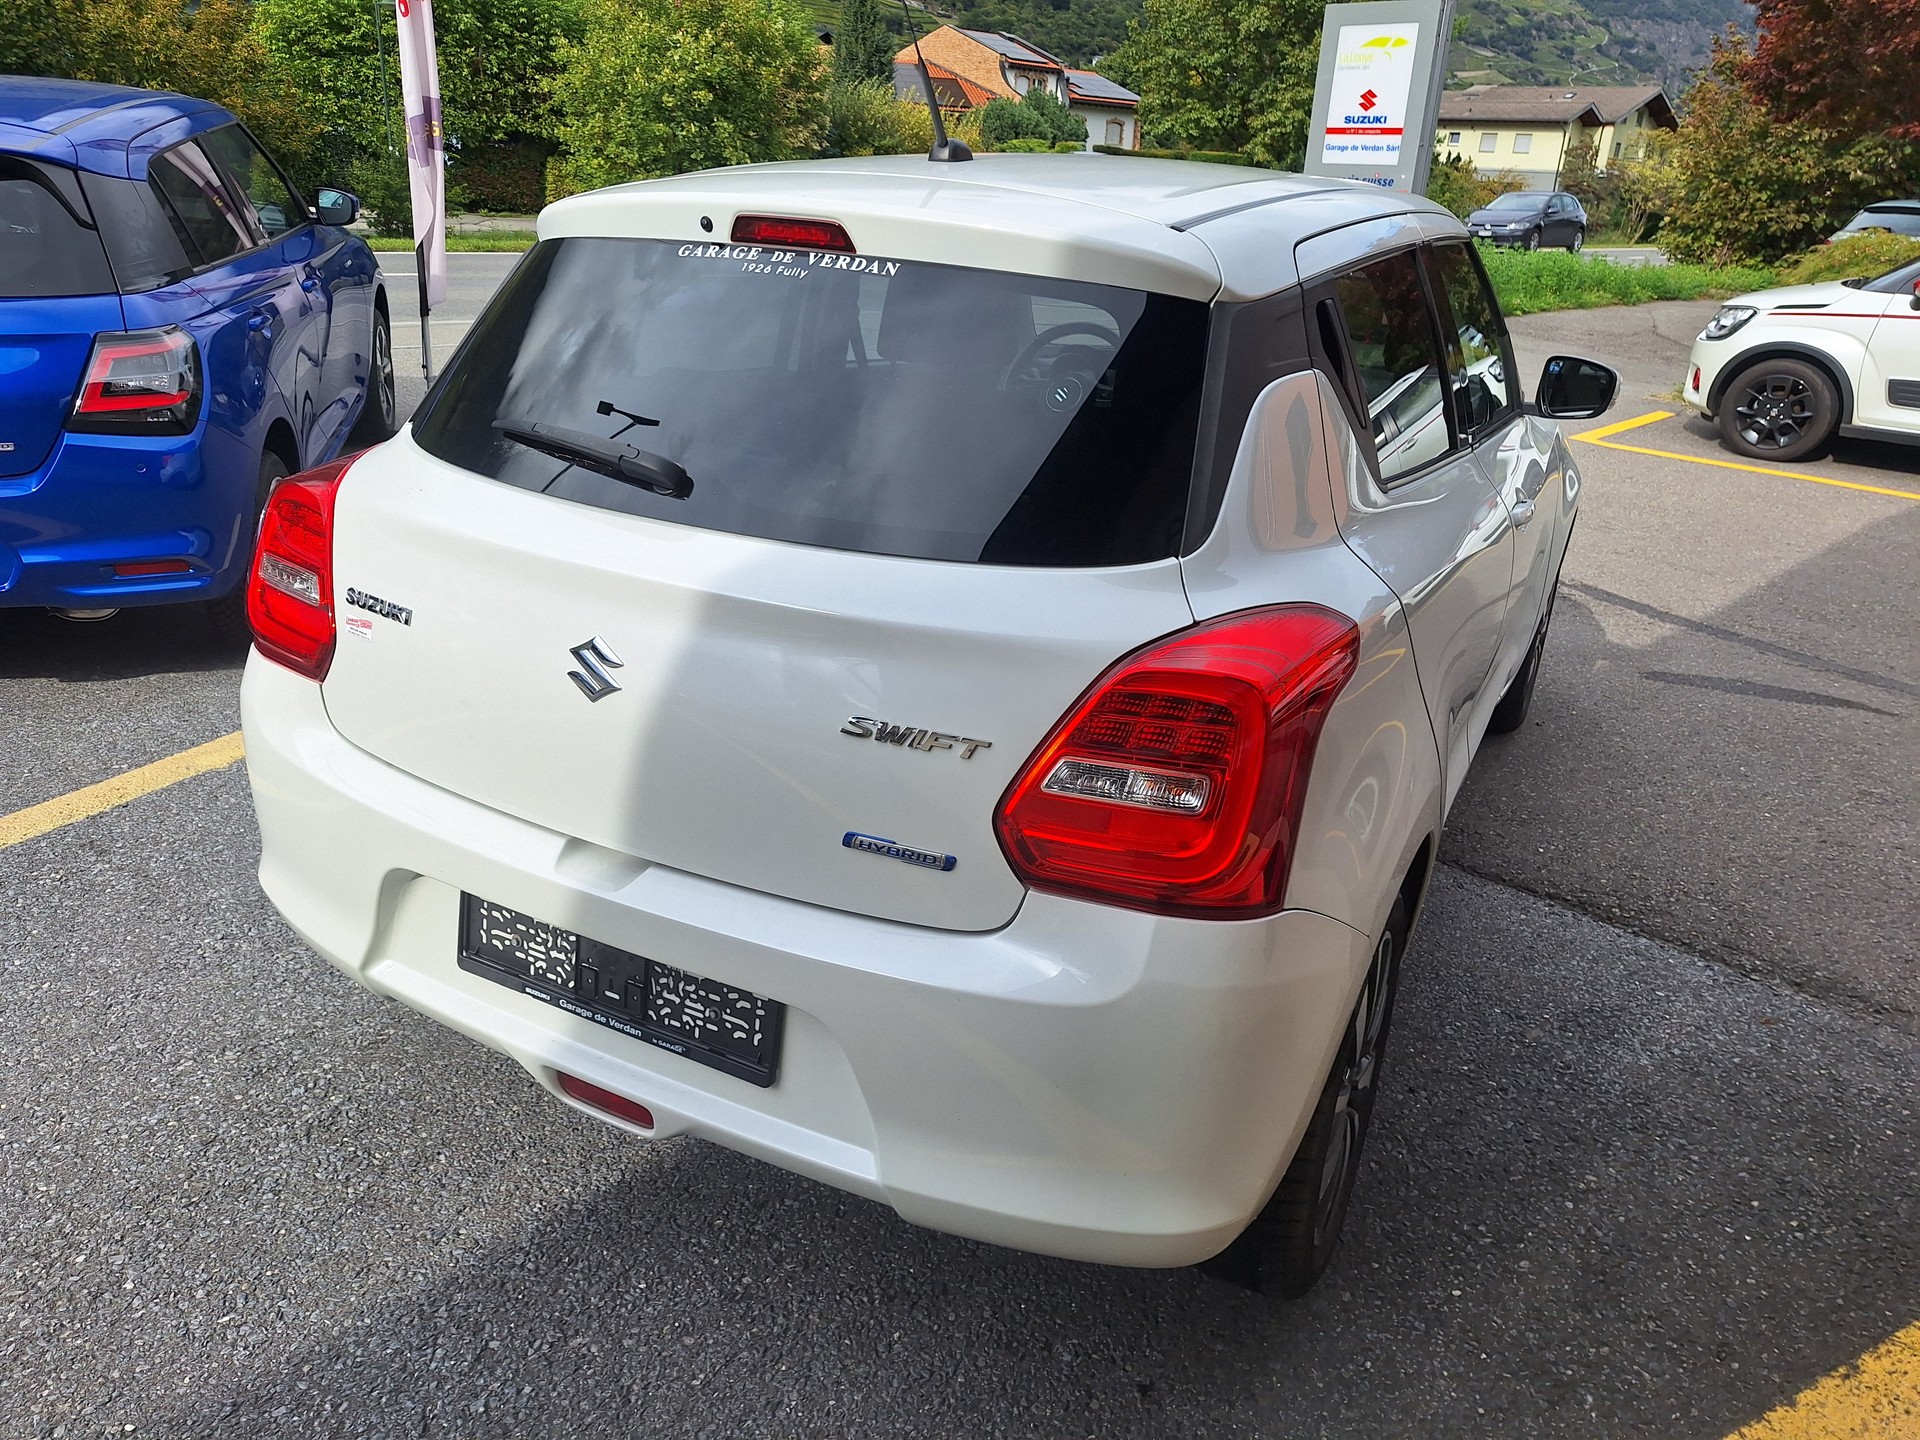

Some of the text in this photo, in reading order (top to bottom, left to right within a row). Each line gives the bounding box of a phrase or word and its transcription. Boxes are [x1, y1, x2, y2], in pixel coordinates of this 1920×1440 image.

[1343, 115, 1388, 124] SUZUKI
[1325, 144, 1349, 152] Garage
[1360, 144, 1384, 152] Verdan
[677, 244, 901, 277] GARAGE DE VERDAN
[741, 262, 809, 279] 1926 Fully
[345, 587, 413, 627] SUZUKI
[840, 715, 993, 760] SWIFT
[858, 840, 937, 865] HYBRID
[525, 986, 550, 1001] SUZUKI
[559, 999, 642, 1037] Garage de Verdan
